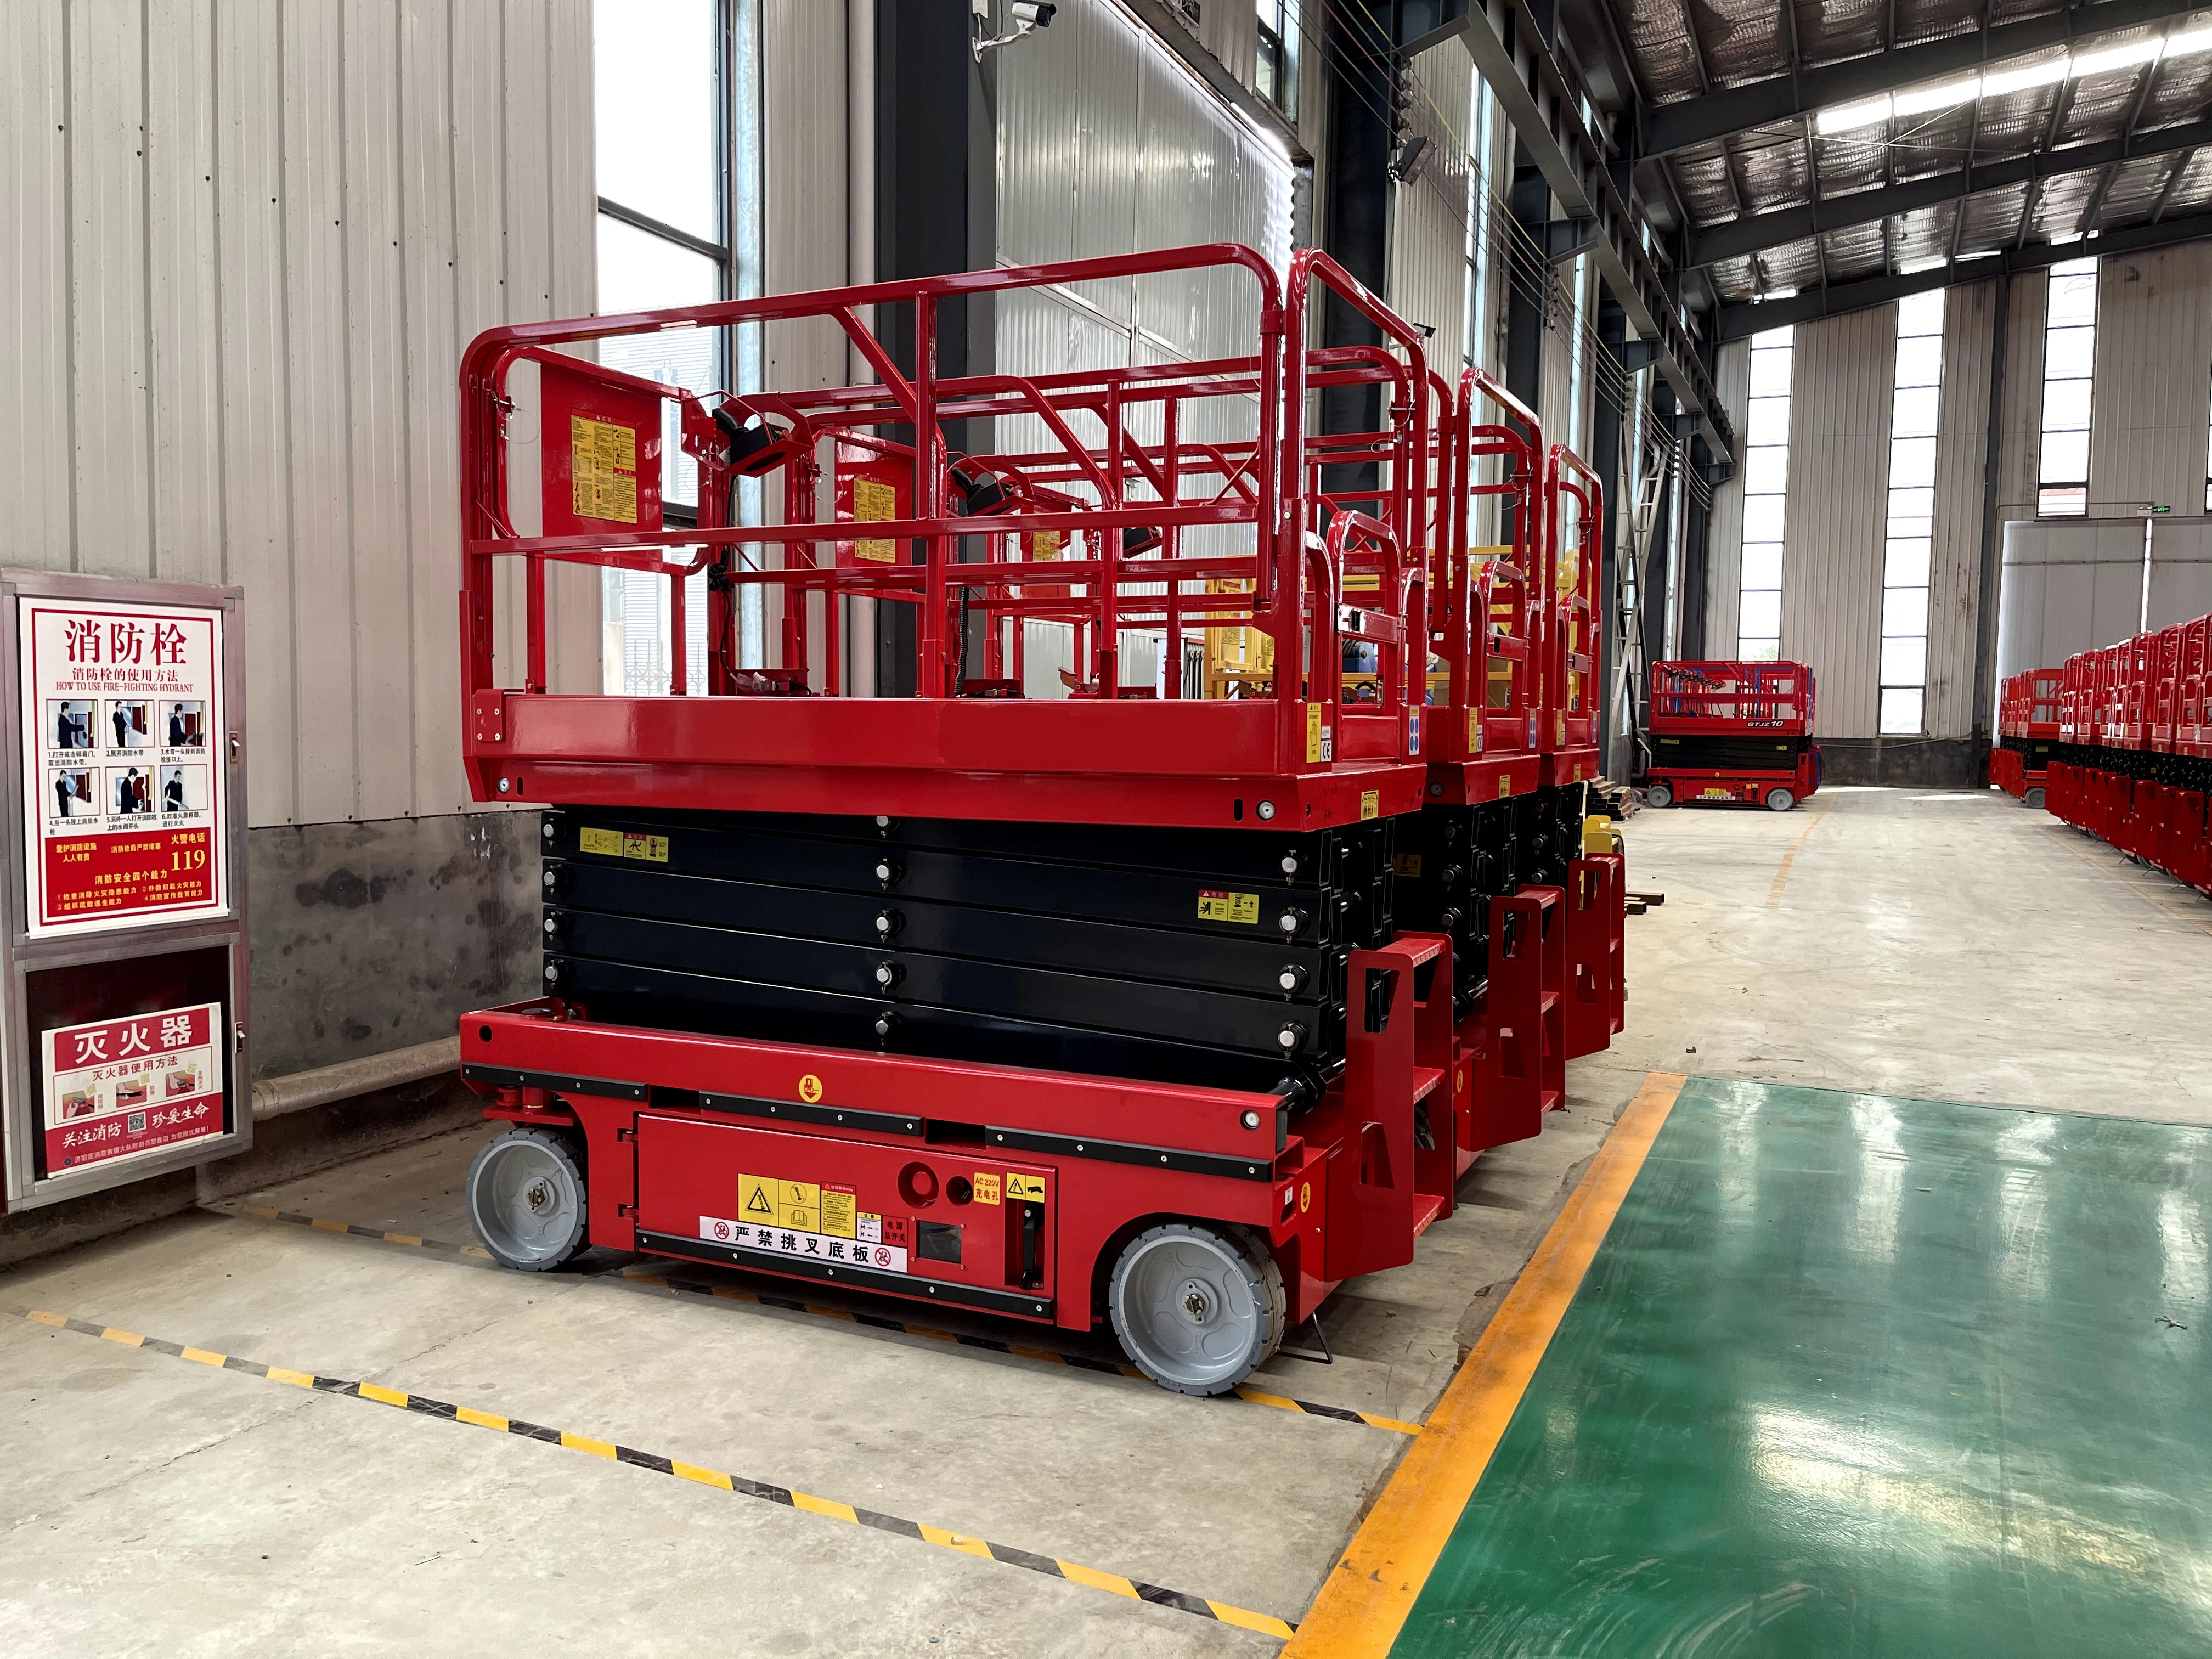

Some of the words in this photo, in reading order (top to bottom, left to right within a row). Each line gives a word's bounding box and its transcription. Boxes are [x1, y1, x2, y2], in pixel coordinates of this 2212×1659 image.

[64, 619, 187, 666] 消防栓
[72, 667, 178, 682] 消防栓的使用方法
[55, 681, 74, 690] HOW
[76, 682, 87, 691] TO
[88, 682, 101, 691] USE
[104, 682, 158, 692] FIRE-FIGHTING
[160, 684, 194, 692] HYDRANT
[171, 832, 205, 845] 火警电话
[55, 842, 97, 853] 爱护消防设施
[63, 853, 90, 863] 人人有责
[171, 849, 206, 871] 119
[94, 868, 168, 885] 消防安全四个能力
[74, 1014, 192, 1064] 灭火器
[92, 1055, 178, 1081] 灭火器使用方法
[62, 1121, 122, 1149] 关注消防
[151, 1101, 210, 1129] 珍爱生命
[985, 1179, 1000, 1187] 220V
[975, 1188, 999, 1201] 充电孔
[887, 1220, 904, 1231] 电源
[735, 1225, 870, 1263] 严禁挑叉底板
[884, 1231, 906, 1243] 总开关
